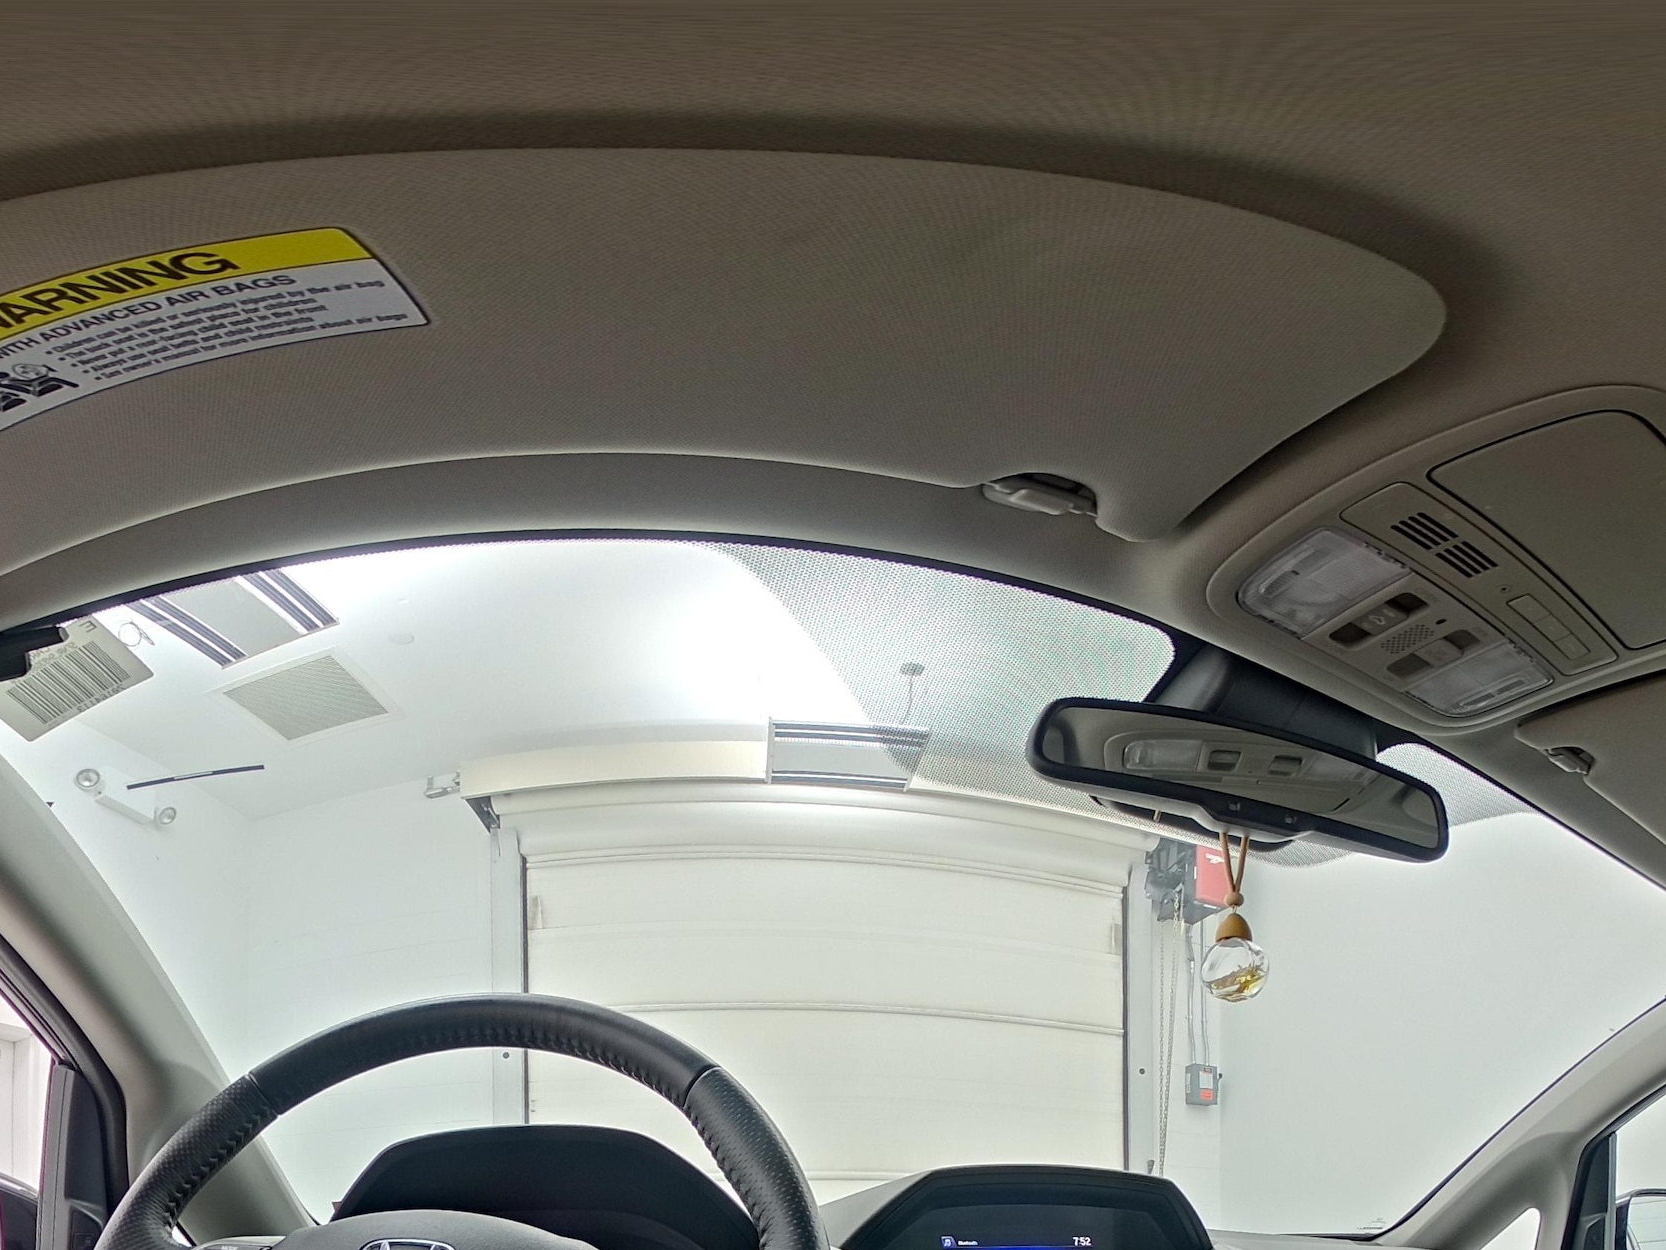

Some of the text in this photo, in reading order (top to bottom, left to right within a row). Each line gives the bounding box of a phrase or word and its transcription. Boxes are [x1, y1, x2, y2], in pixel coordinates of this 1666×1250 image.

[39, 301, 162, 342] ADVANCED
[165, 289, 210, 307] AIR
[211, 275, 297, 296] BAGS
[51, 336, 97, 353] Children
[96, 329, 116, 340] can
[116, 324, 133, 334] be
[132, 316, 166, 330] killed
[166, 313, 179, 321] or
[181, 301, 237, 318] seriously
[306, 286, 331, 295] the
[333, 282, 353, 292] air
[355, 279, 386, 289] bag
[66, 350, 85, 360] The
[148, 325, 169, 336] the
[262, 297, 318, 311] children
[1072, 1236, 1092, 1246] 7:52
